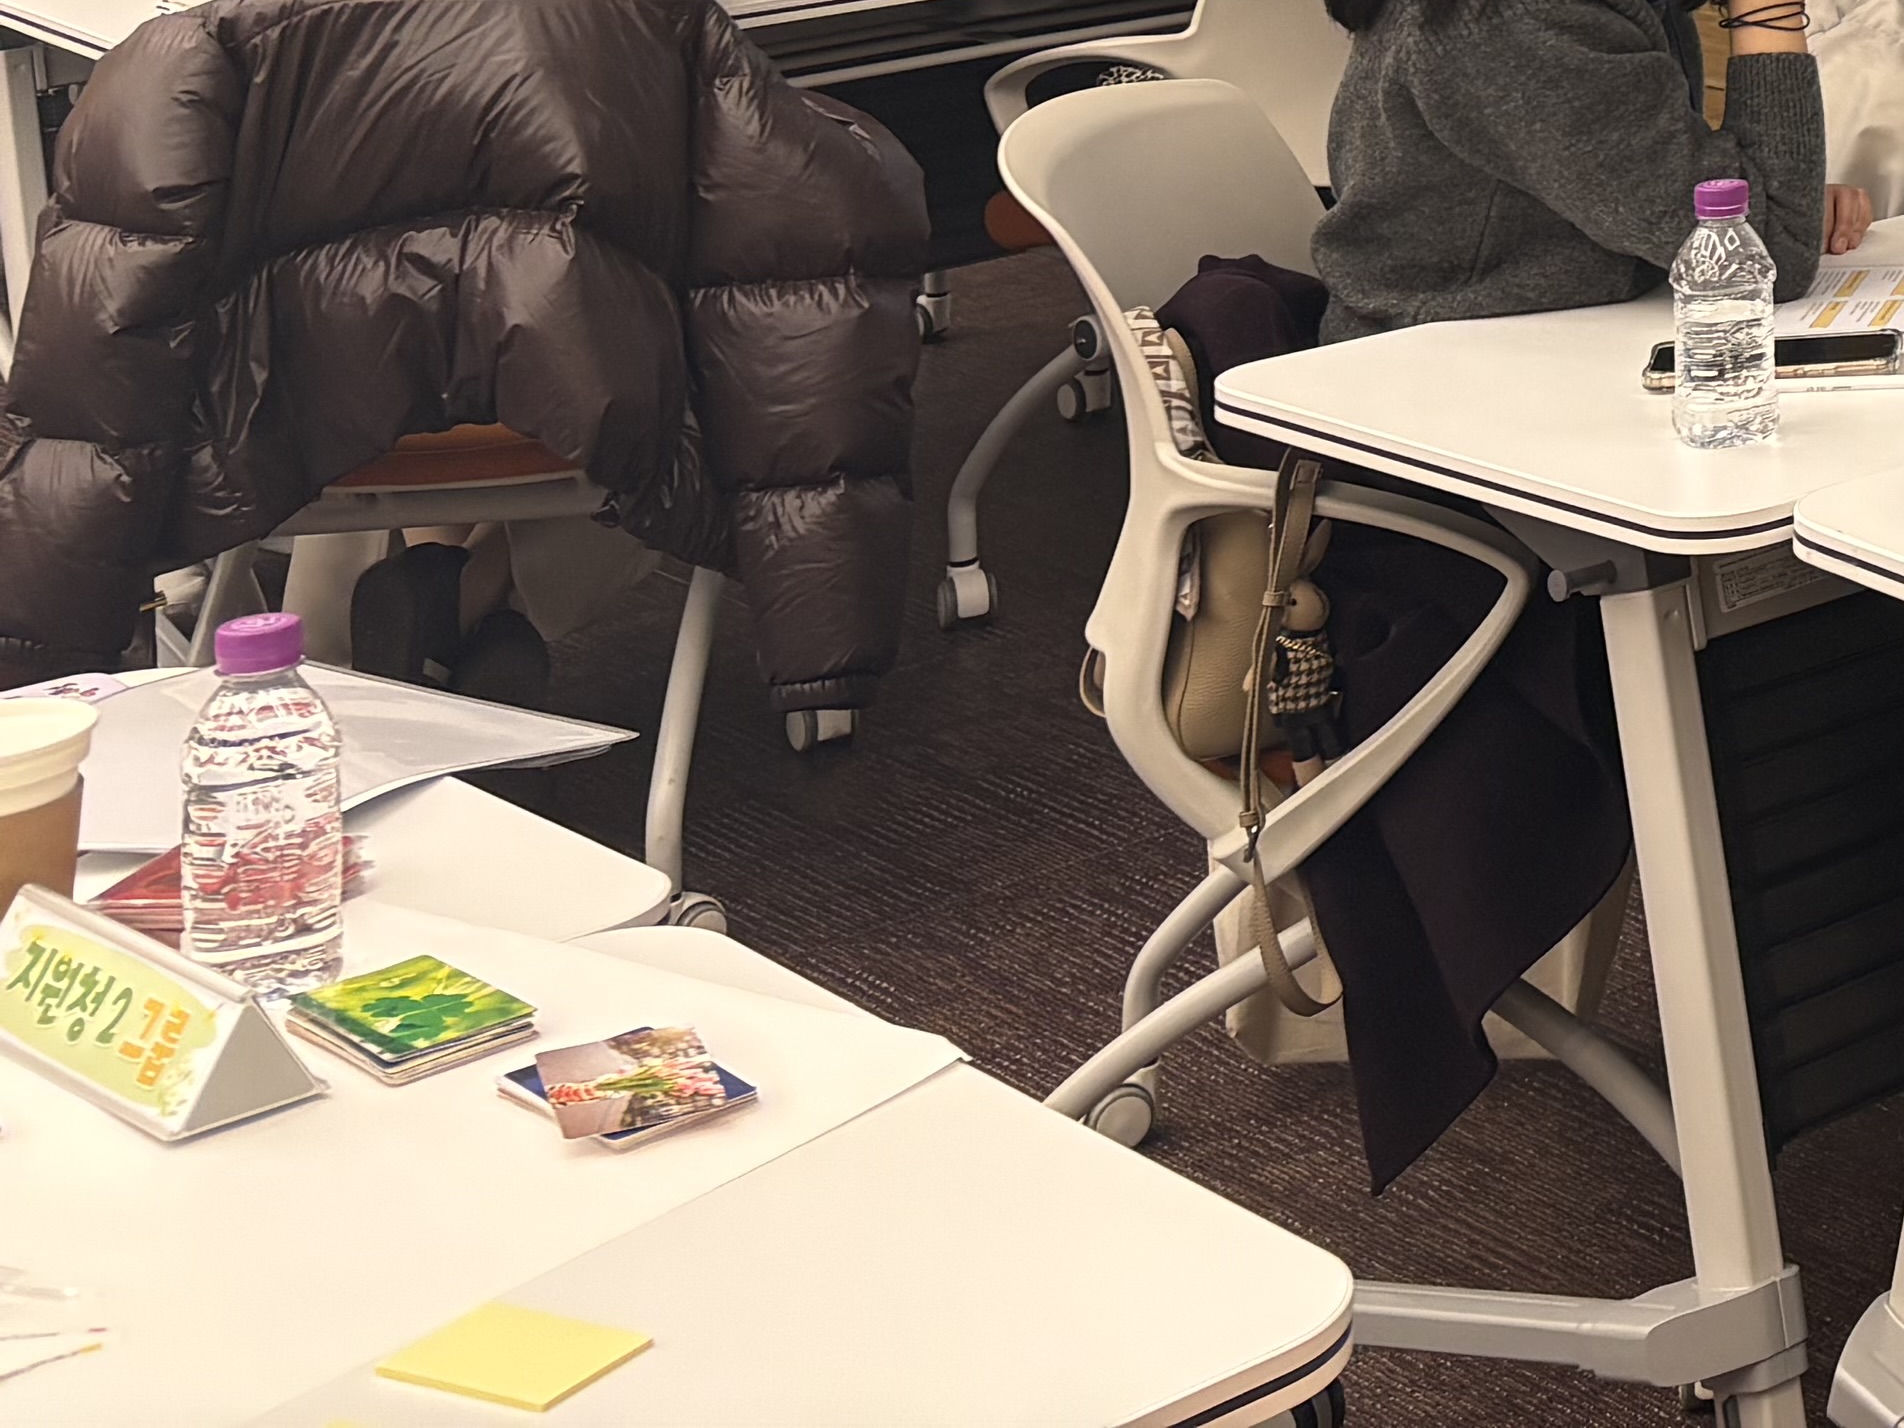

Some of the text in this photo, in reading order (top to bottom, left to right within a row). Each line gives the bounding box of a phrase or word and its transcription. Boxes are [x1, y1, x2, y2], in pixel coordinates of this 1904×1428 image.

[6, 940, 191, 1086] 지원청 2 그룹
